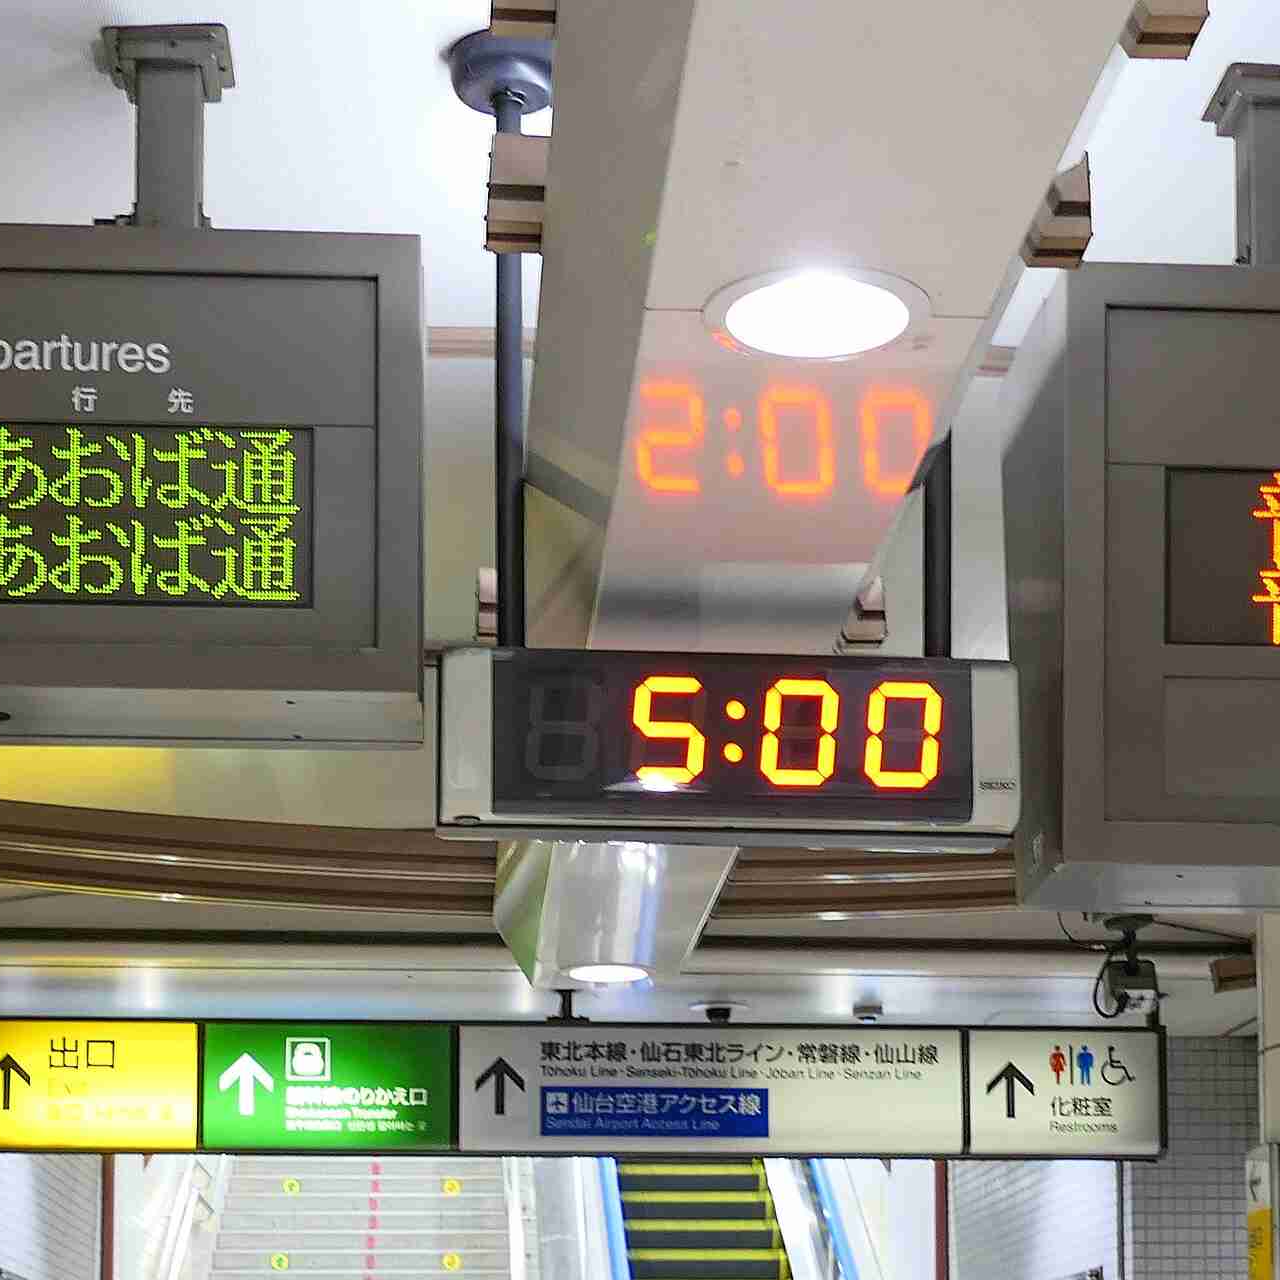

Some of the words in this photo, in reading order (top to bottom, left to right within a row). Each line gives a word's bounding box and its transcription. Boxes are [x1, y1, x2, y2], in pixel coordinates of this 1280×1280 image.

[631, 675, 944, 790] 5:00
[48, 1036, 115, 1069] 出口
[1050, 1096, 1113, 1117] 化粧室
